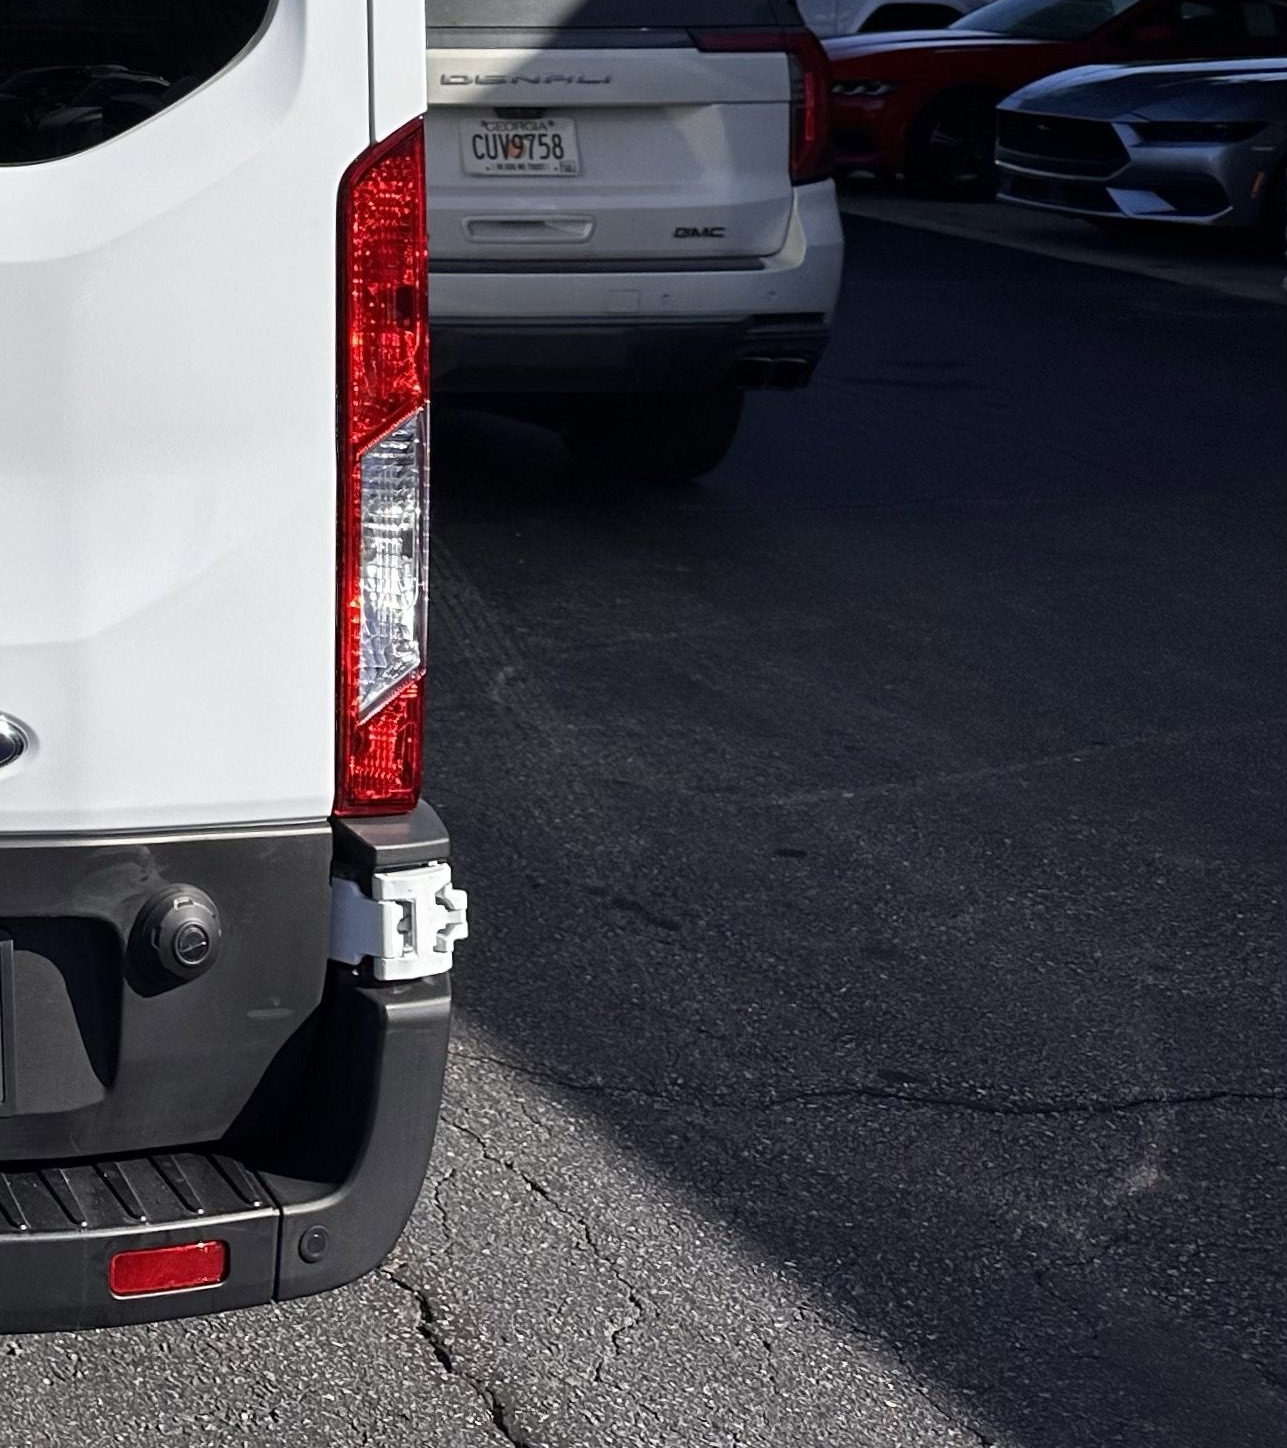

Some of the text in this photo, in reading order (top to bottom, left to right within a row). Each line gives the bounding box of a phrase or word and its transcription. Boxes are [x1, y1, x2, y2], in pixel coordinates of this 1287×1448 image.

[440, 74, 611, 85] DENALI
[483, 119, 548, 132] GEORGIA
[472, 133, 565, 160] CUV9758
[672, 226, 727, 239] GMC
